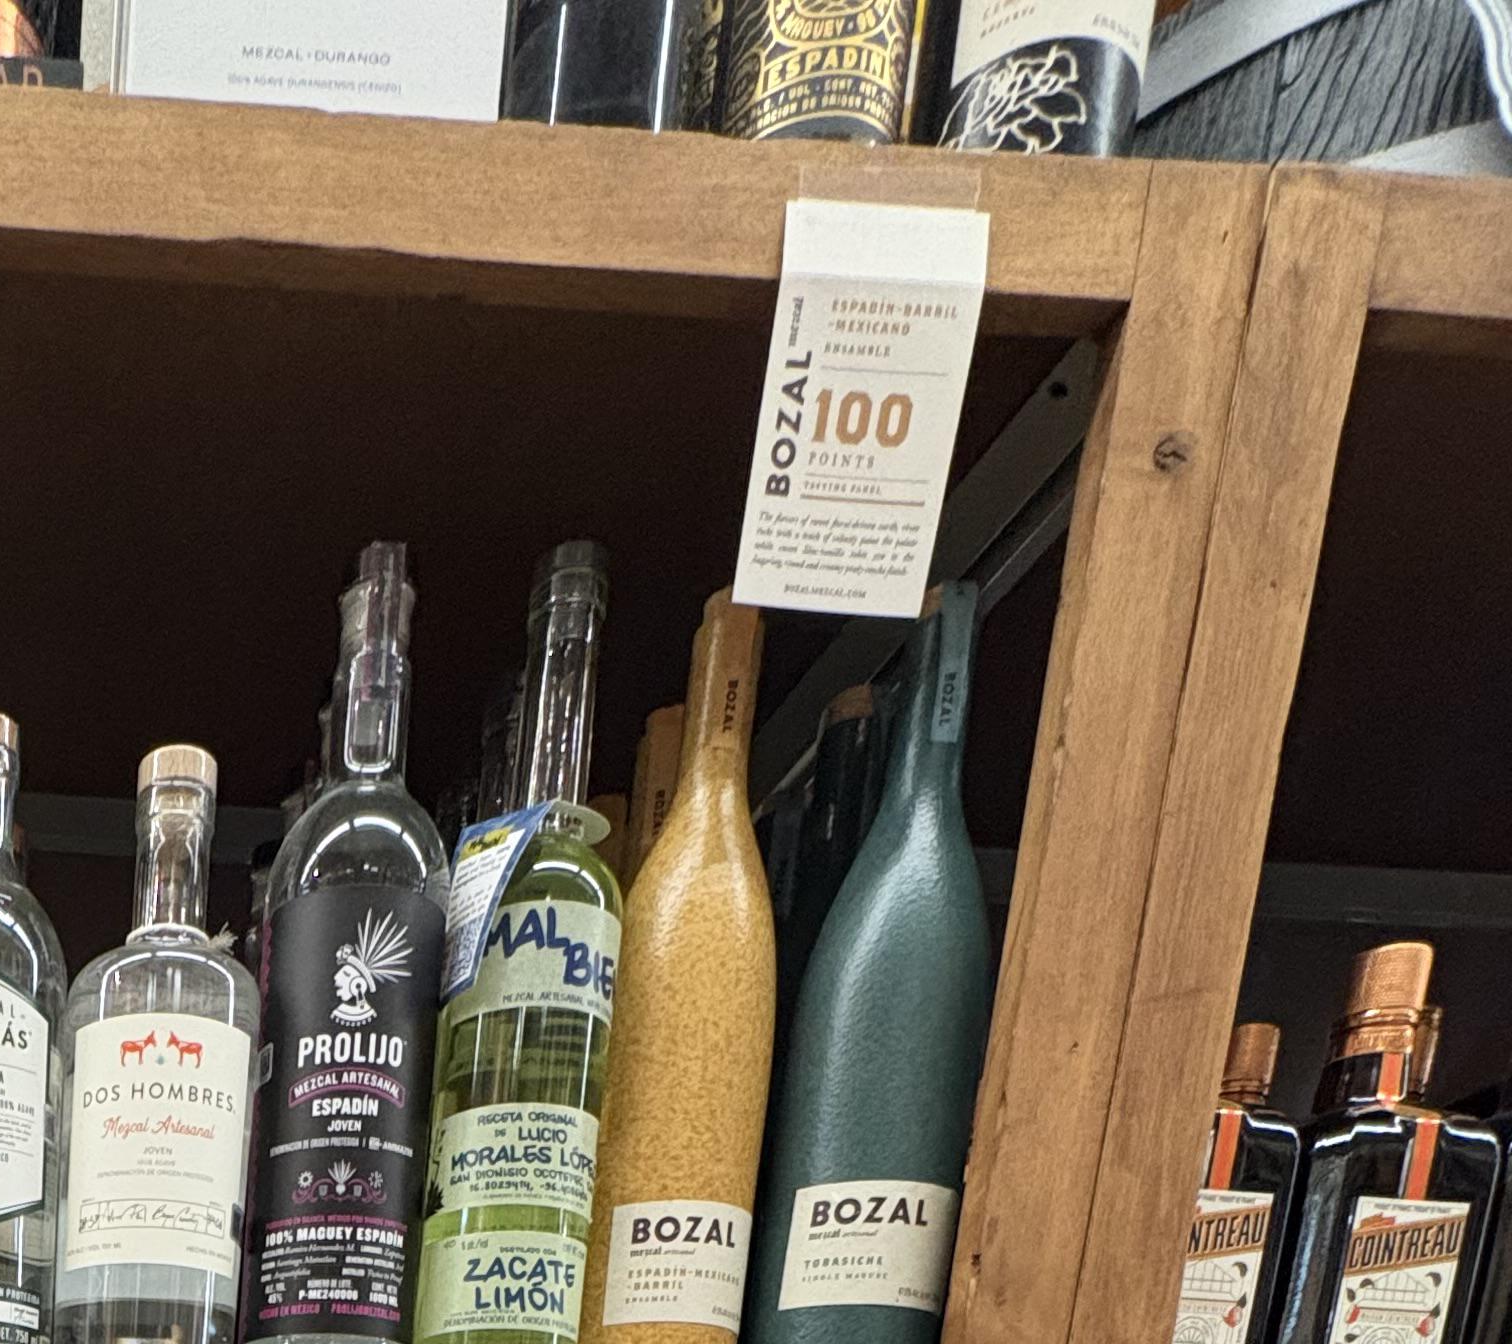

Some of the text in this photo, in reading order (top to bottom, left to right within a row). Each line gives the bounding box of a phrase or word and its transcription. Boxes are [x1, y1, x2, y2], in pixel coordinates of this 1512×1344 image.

[241, 45, 392, 68] MEZCAL DURANGO
[764, 350, 813, 498] BOZAL
[811, 388, 914, 449] 100
[808, 451, 875, 469] POINTS
[722, 678, 739, 734] BOZAL
[938, 670, 957, 728] BOZAL
[482, 907, 569, 964] MAL
[297, 1032, 403, 1068] PROLIJO
[83, 1085, 124, 1109] DOS
[293, 1070, 400, 1098] MEZCAL ARTESANAL
[312, 1095, 378, 1117] ESPADÍN
[102, 1116, 214, 1140] Mezcal Artesanal
[327, 1119, 361, 1132] JOVEN
[518, 1127, 568, 1144] LUCIO
[143, 1146, 172, 1154] JOVEN
[451, 1146, 555, 1171] MORALES
[809, 1196, 928, 1228] BOZAL
[266, 1226, 404, 1247] 100% MAGUEY ESPADÍN
[630, 1216, 736, 1248] BOZAL
[1348, 1220, 1460, 1268] COINTREAU
[465, 1257, 575, 1288] ZACATE
[803, 1255, 883, 1269] TOBASICHE
[474, 1281, 565, 1313] LIMÓN
